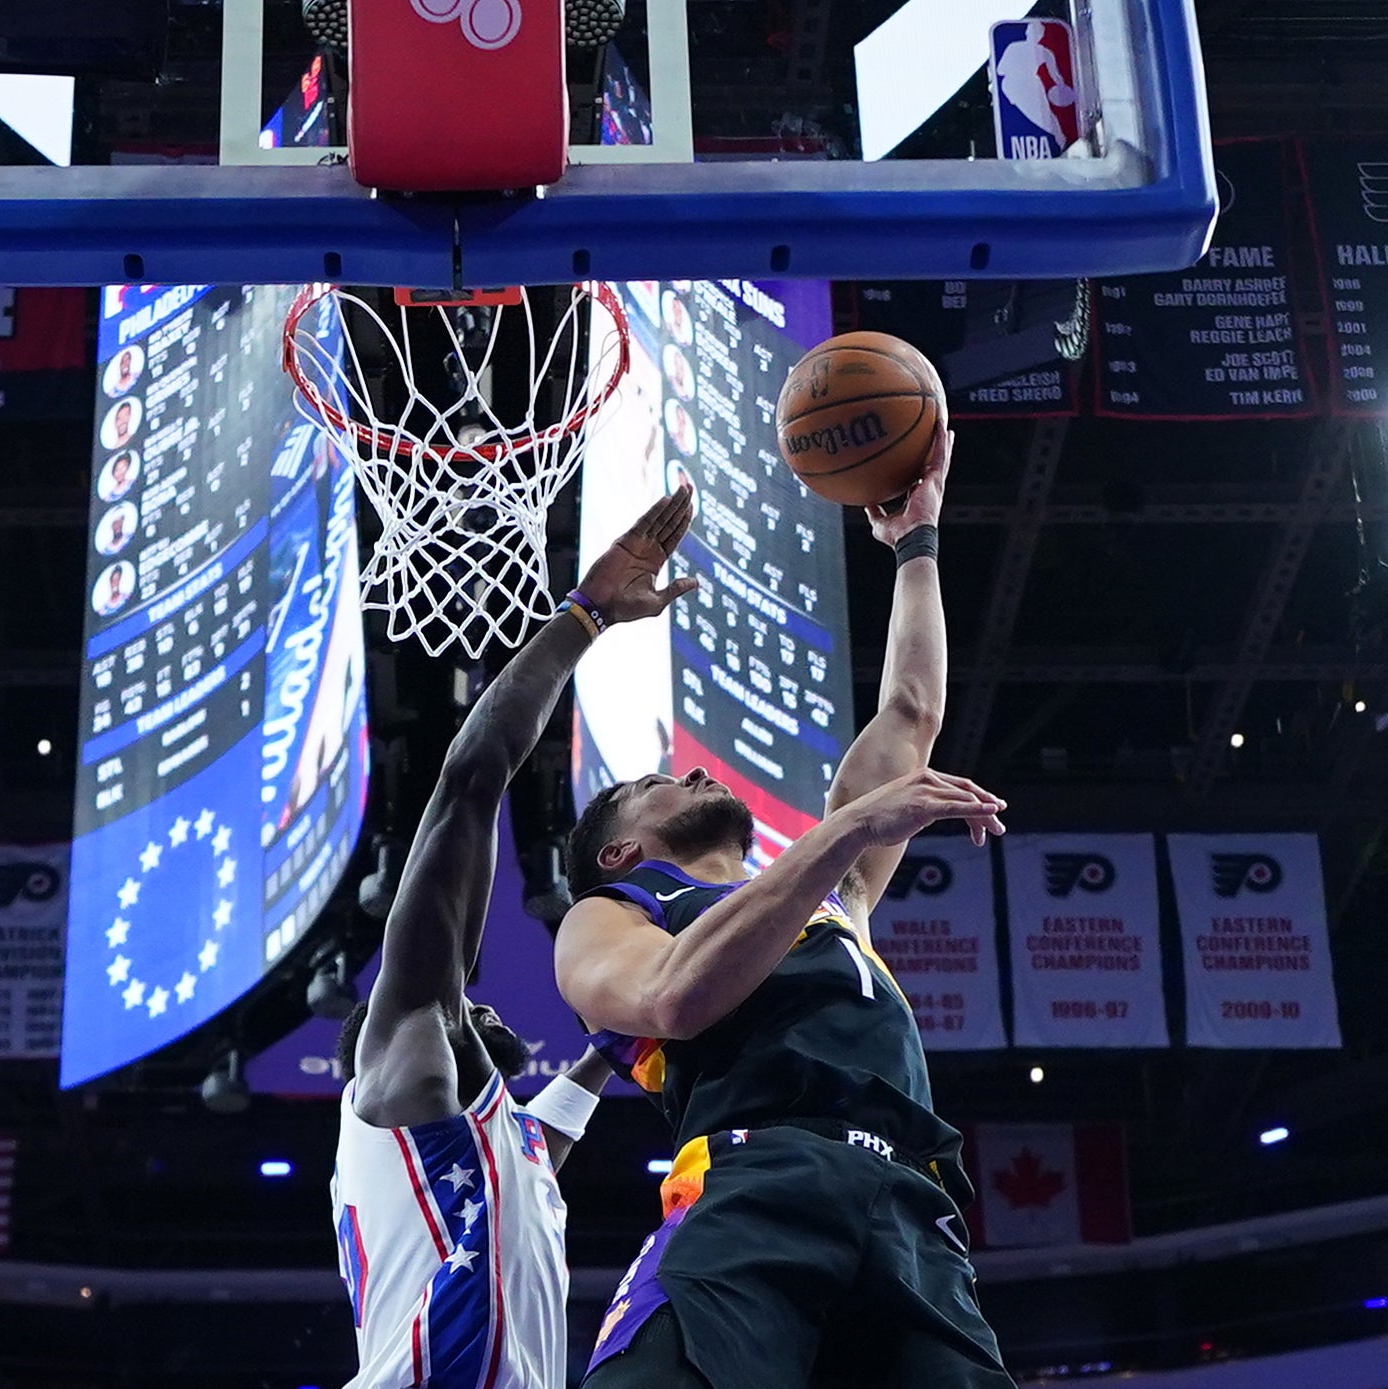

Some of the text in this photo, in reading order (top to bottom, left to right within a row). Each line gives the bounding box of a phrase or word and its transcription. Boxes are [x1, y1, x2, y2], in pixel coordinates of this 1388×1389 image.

[1011, 136, 1052, 159] NBA
[1210, 246, 1275, 268] FAME
[1182, 278, 1232, 293] BARRY
[742, 280, 786, 328] SUNS
[1154, 293, 1193, 306] GARY
[1215, 315, 1252, 330] GENE
[1190, 327, 1292, 344] REGGIE LEACH
[753, 344, 773, 362] AST
[1222, 350, 1295, 367] JOE SCOTT
[1205, 365, 1299, 382] ED VAN IMPE
[755, 395, 776, 415] AST
[1229, 391, 1259, 405] TIM
[784, 411, 888, 456] Wilson
[758, 449, 778, 467] AST
[760, 502, 780, 520] AST
[796, 523, 815, 542] FLS
[148, 562, 223, 622] TEAM STATS
[763, 562, 783, 581] AST
[798, 583, 818, 603] FLS
[713, 562, 787, 624] TEAM STATS
[754, 631, 764, 647] 2
[778, 633, 796, 651] TO
[807, 650, 827, 670] FLS
[682, 668, 704, 696] STL
[749, 669, 772, 693] 100
[136, 665, 226, 733] TEAM LEADERS
[710, 664, 799, 735] TEAM LEADERS
[683, 696, 705, 725] BLK
[97, 758, 123, 782] STL
[96, 784, 123, 809] BLK
[892, 920, 951, 937] WALES
[1042, 917, 1124, 934] EASTERN
[1212, 917, 1293, 933] EASTERN
[1026, 934, 1143, 953] CONFERENCE
[1196, 935, 1311, 953] CONFERENCE
[1031, 954, 1141, 972] CHAMPIONS
[1203, 954, 1310, 972] CHAMPIONS
[847, 1129, 894, 1163] PHX
